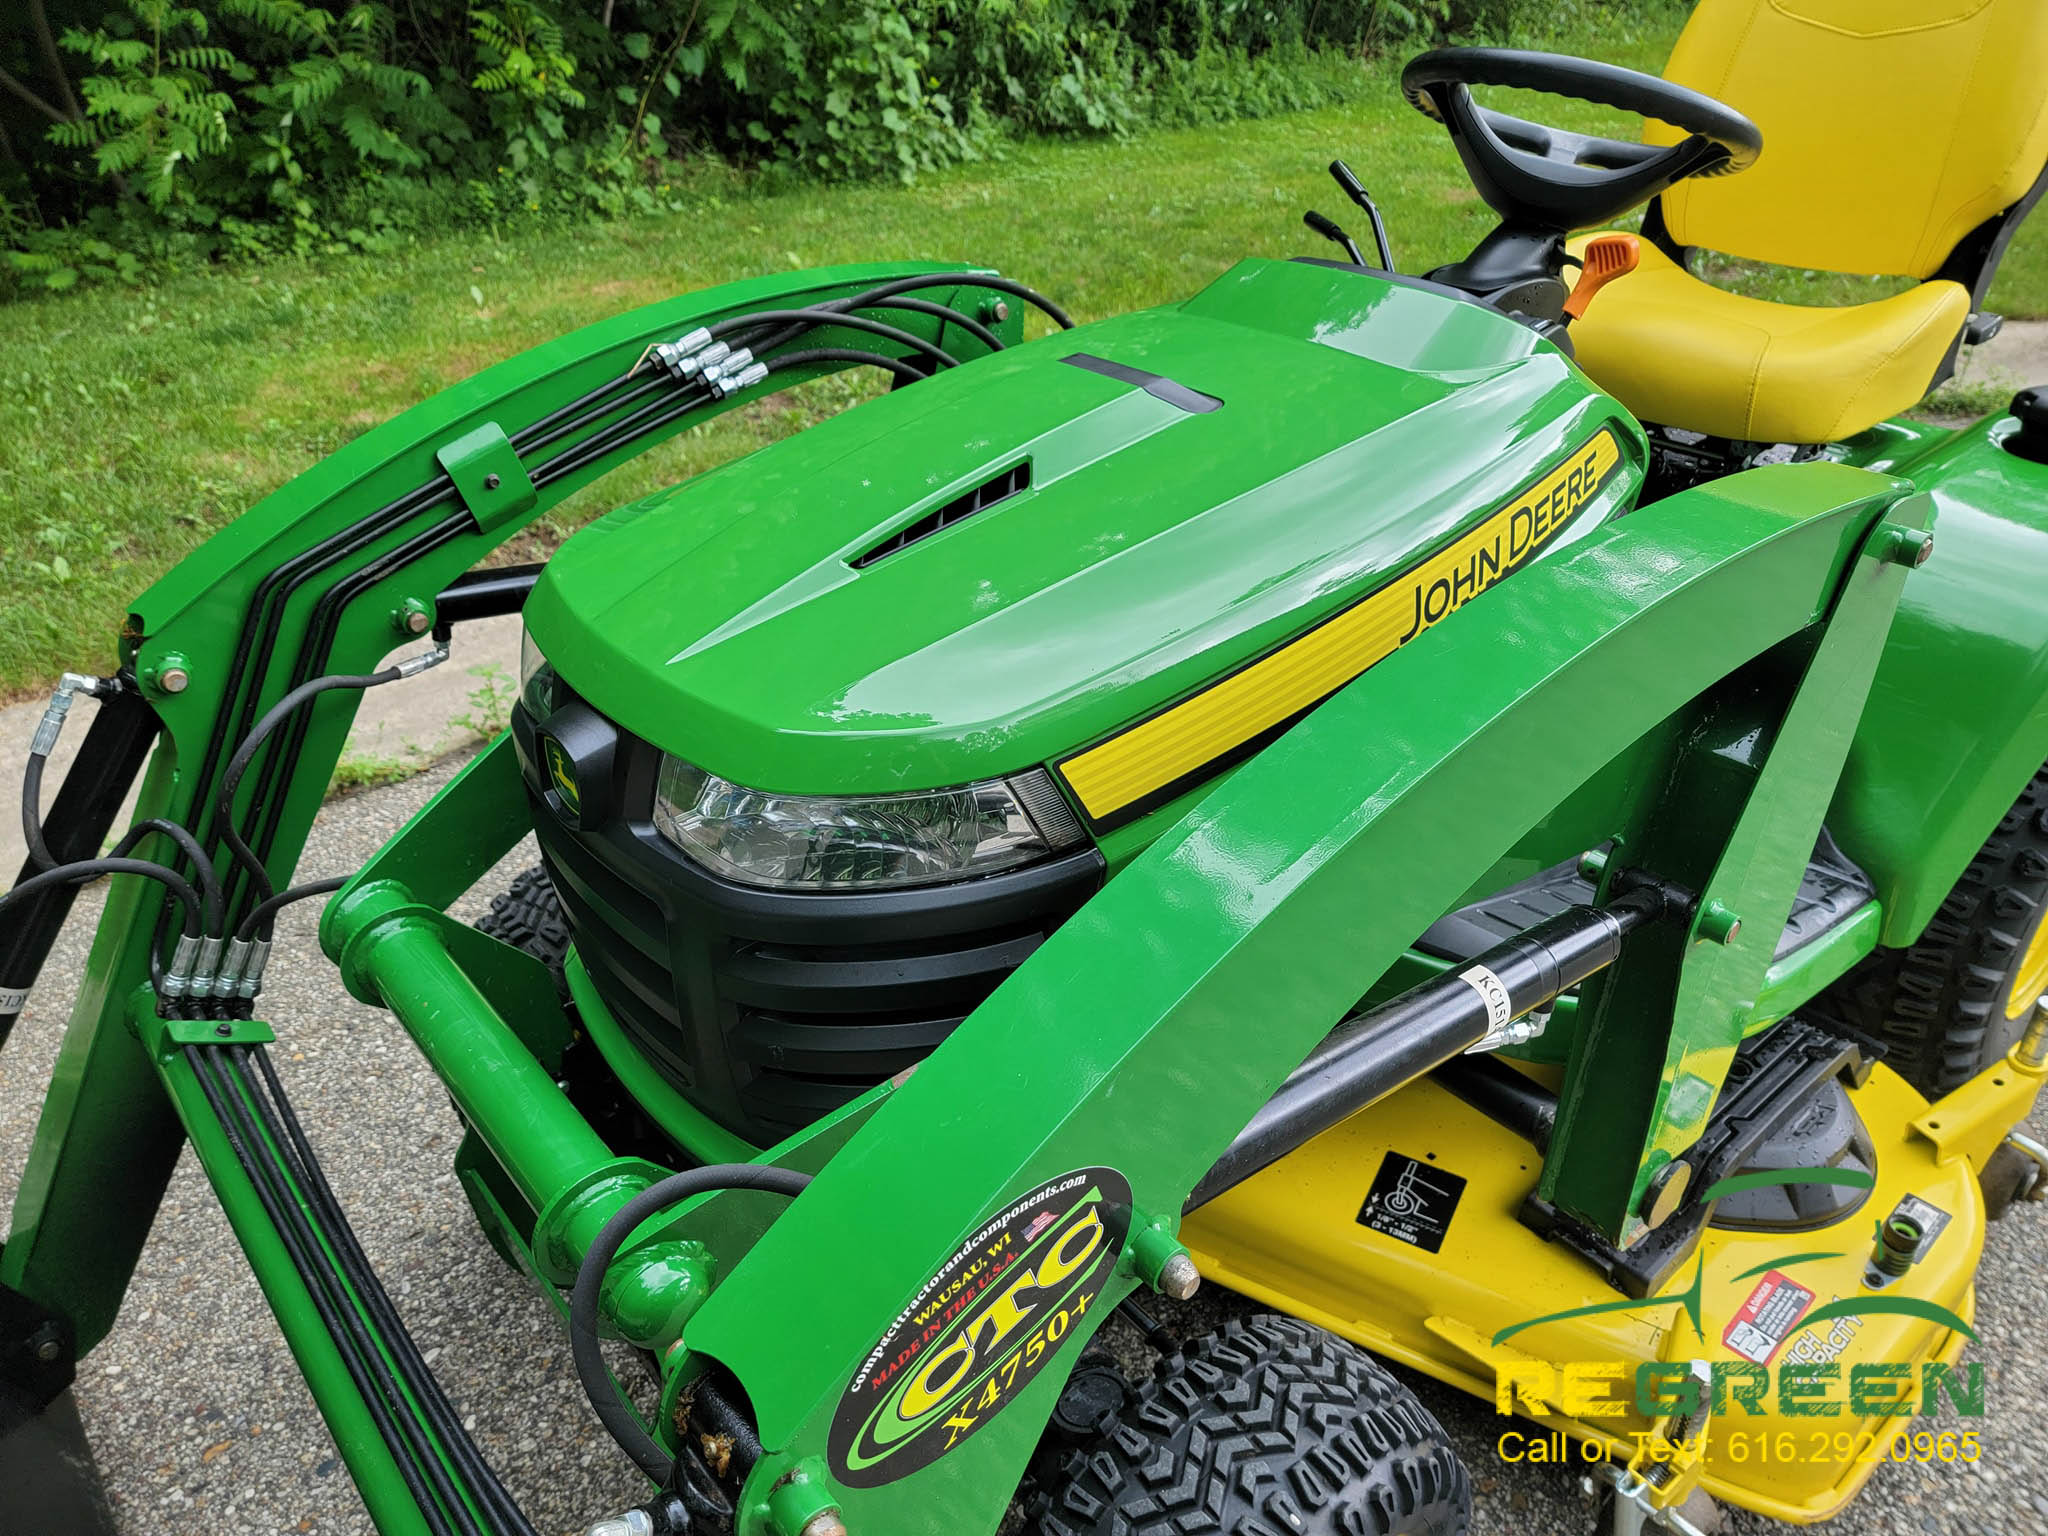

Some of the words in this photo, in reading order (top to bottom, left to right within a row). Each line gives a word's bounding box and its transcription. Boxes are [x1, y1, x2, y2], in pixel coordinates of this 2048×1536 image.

[1399, 536, 1500, 647] JOHN
[1509, 450, 1598, 559] DEERE
[851, 1173, 1087, 1393] compacttractorandcomponents.com
[871, 1337, 921, 1390] MADE
[921, 1321, 942, 1339] IN
[944, 1287, 978, 1324] THE
[978, 1252, 1019, 1291] U.S.A.
[897, 1205, 1104, 1422] CTC
[913, 1256, 988, 1327] WAUSAU,
[986, 1232, 1012, 1259] WI
[941, 1292, 1094, 1450] X4750+
